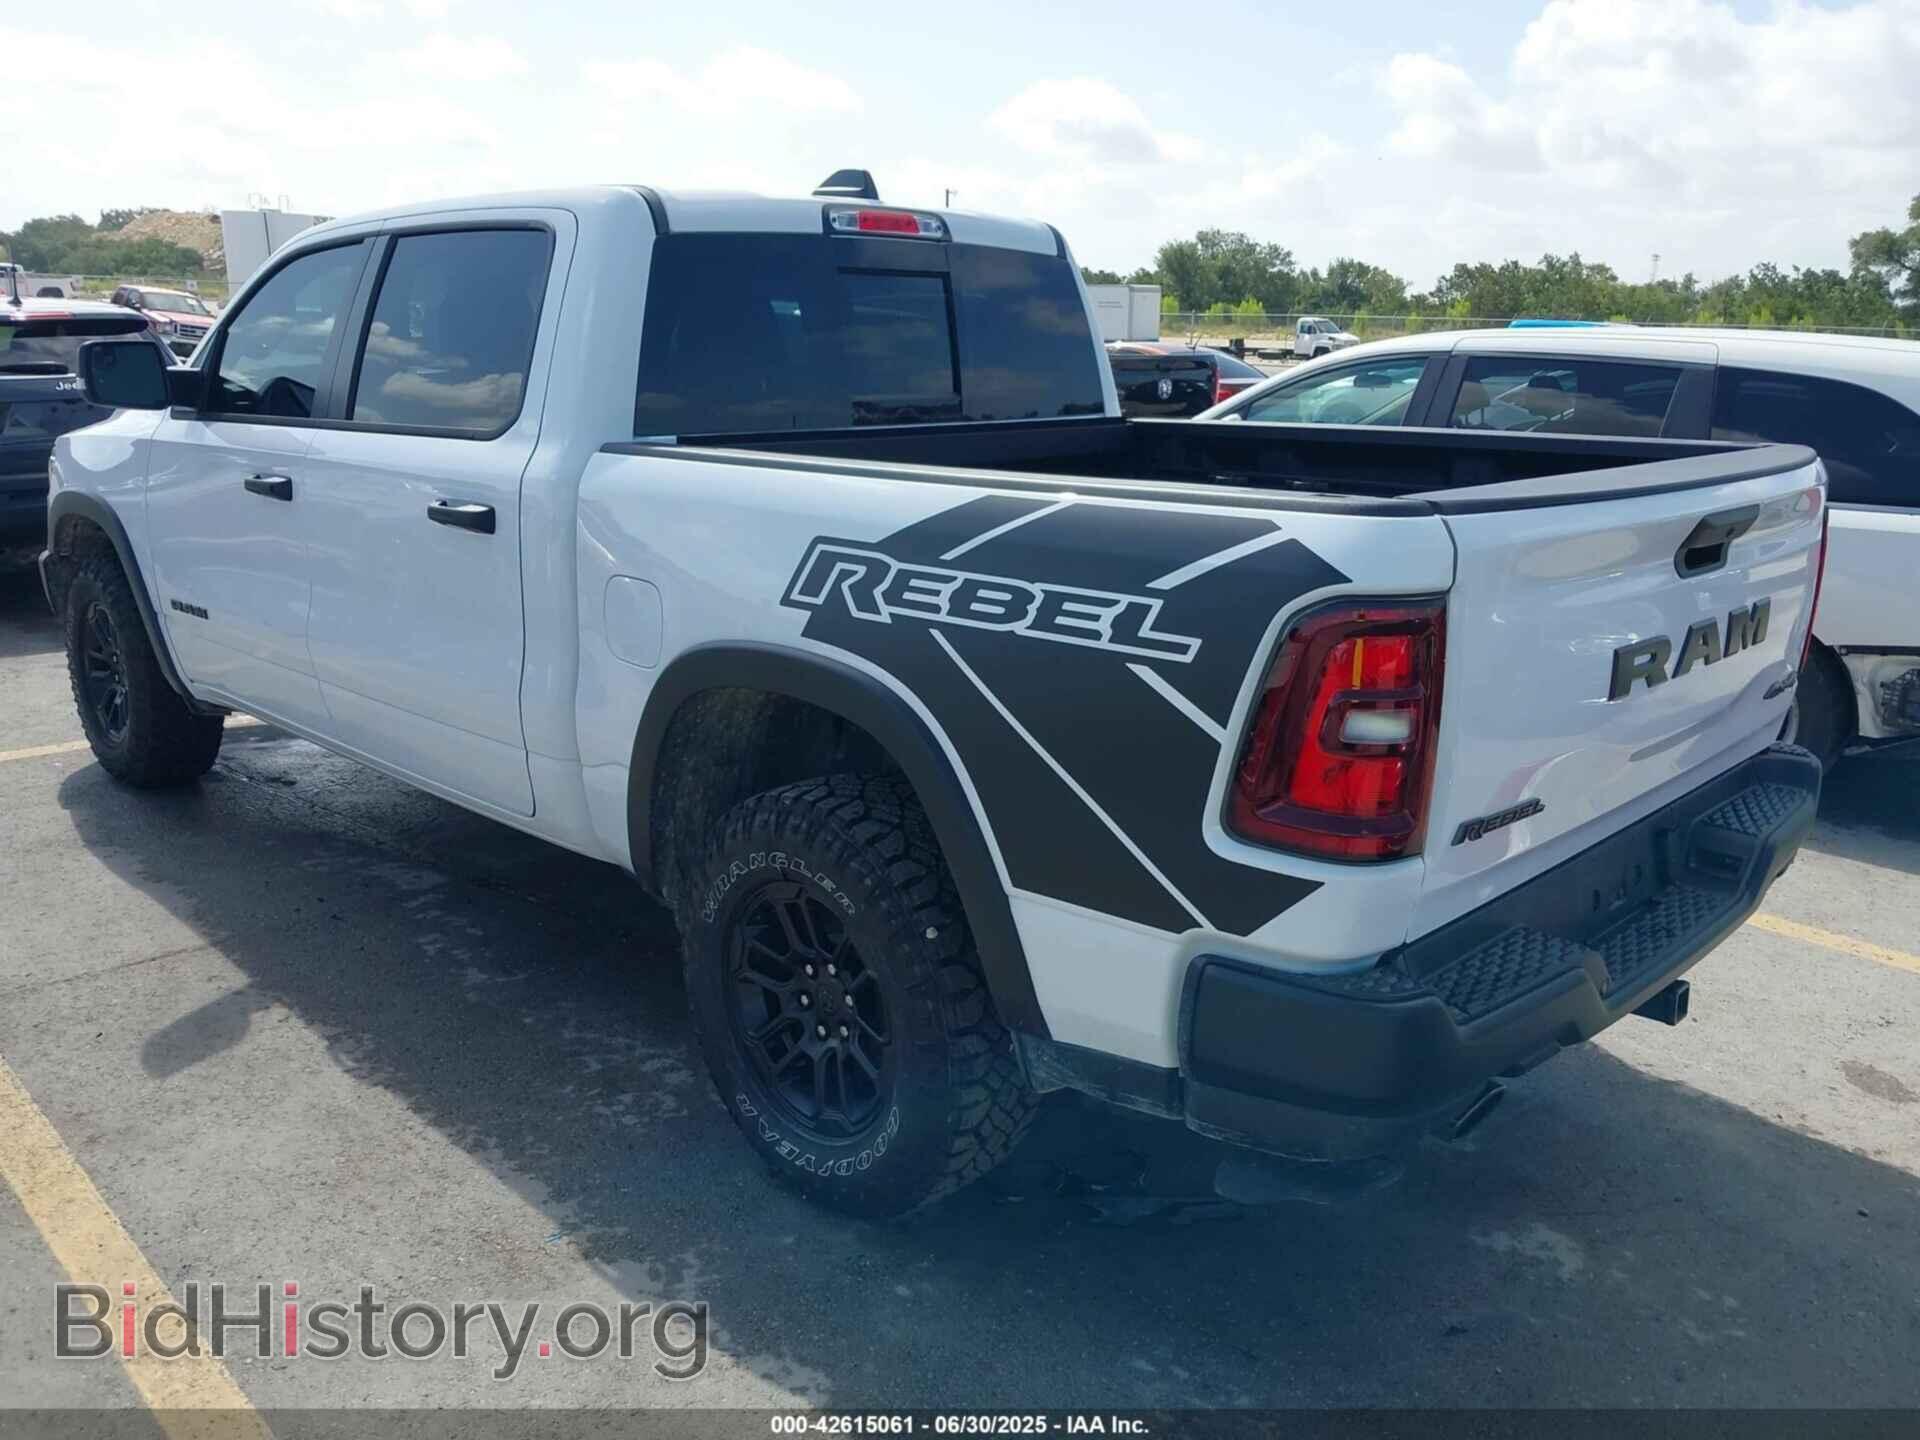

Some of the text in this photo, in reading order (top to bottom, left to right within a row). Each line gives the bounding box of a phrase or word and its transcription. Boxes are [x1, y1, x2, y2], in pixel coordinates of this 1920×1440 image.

[790, 543, 1203, 663] REBEL
[1607, 597, 1772, 702] RAM
[1451, 798, 1546, 847] REBEL
[702, 851, 856, 923] WRANGLER
[735, 1093, 900, 1177] GOODYEAR
